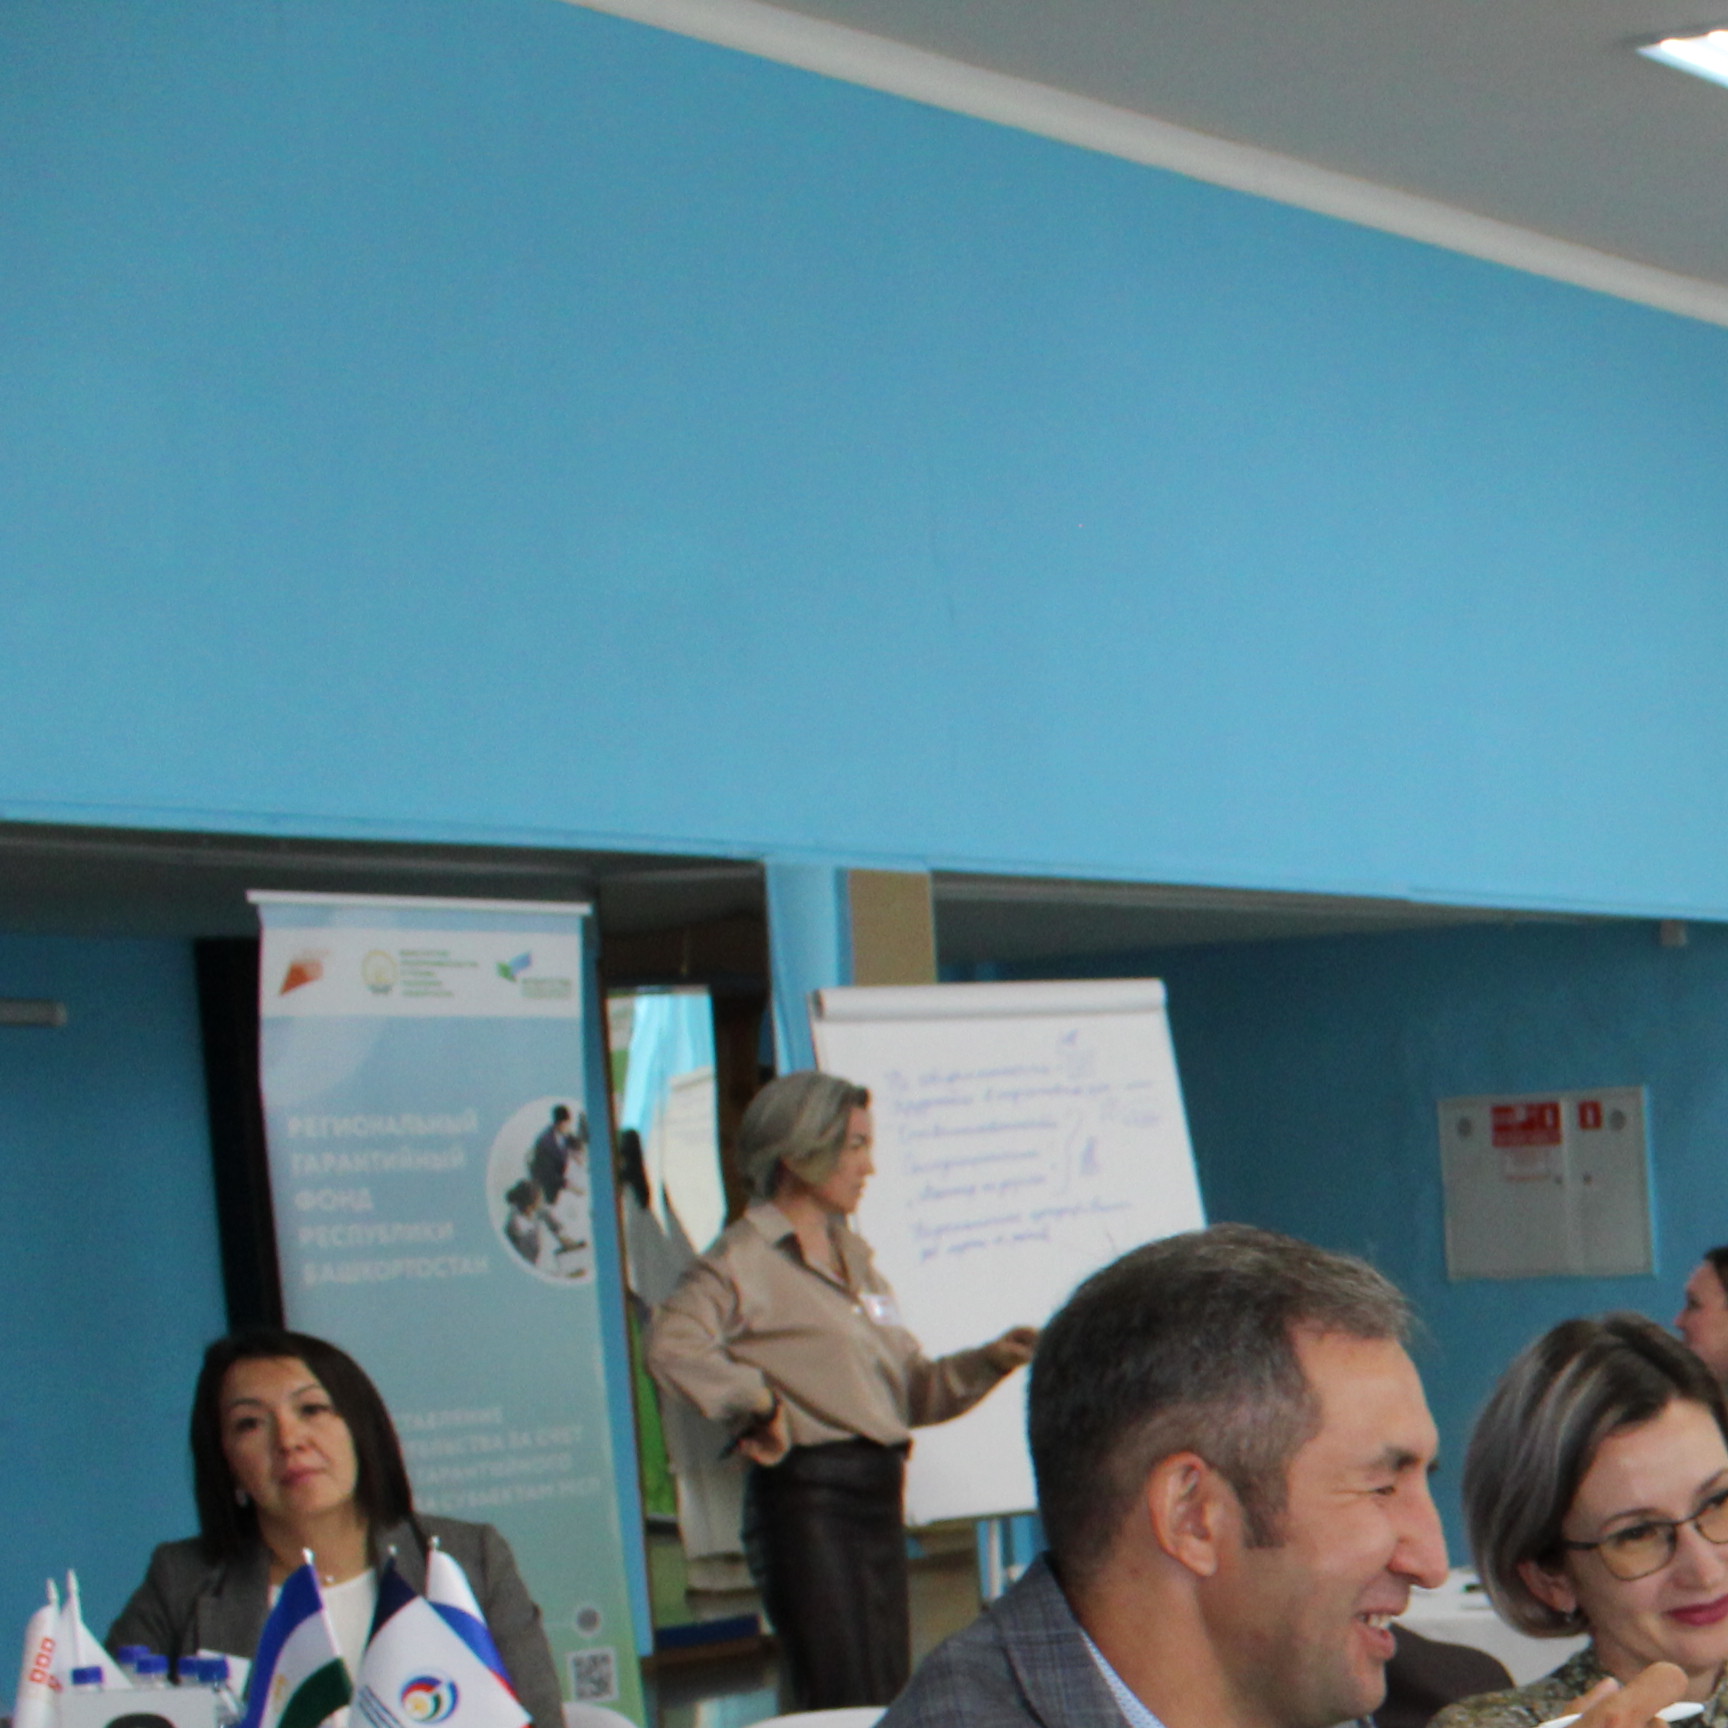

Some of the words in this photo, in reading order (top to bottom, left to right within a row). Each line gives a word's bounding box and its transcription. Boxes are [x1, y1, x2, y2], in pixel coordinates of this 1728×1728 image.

[287, 1108, 478, 1138] РЕГИОНАЛЬНЫЙ
[291, 1146, 466, 1178] ГАРАНТИЙНЫЙ
[295, 1187, 374, 1213] ФОНД
[299, 1220, 454, 1249] РЕСПУБЛИКИ
[303, 1255, 489, 1290] БАШКОРТОСТАН
